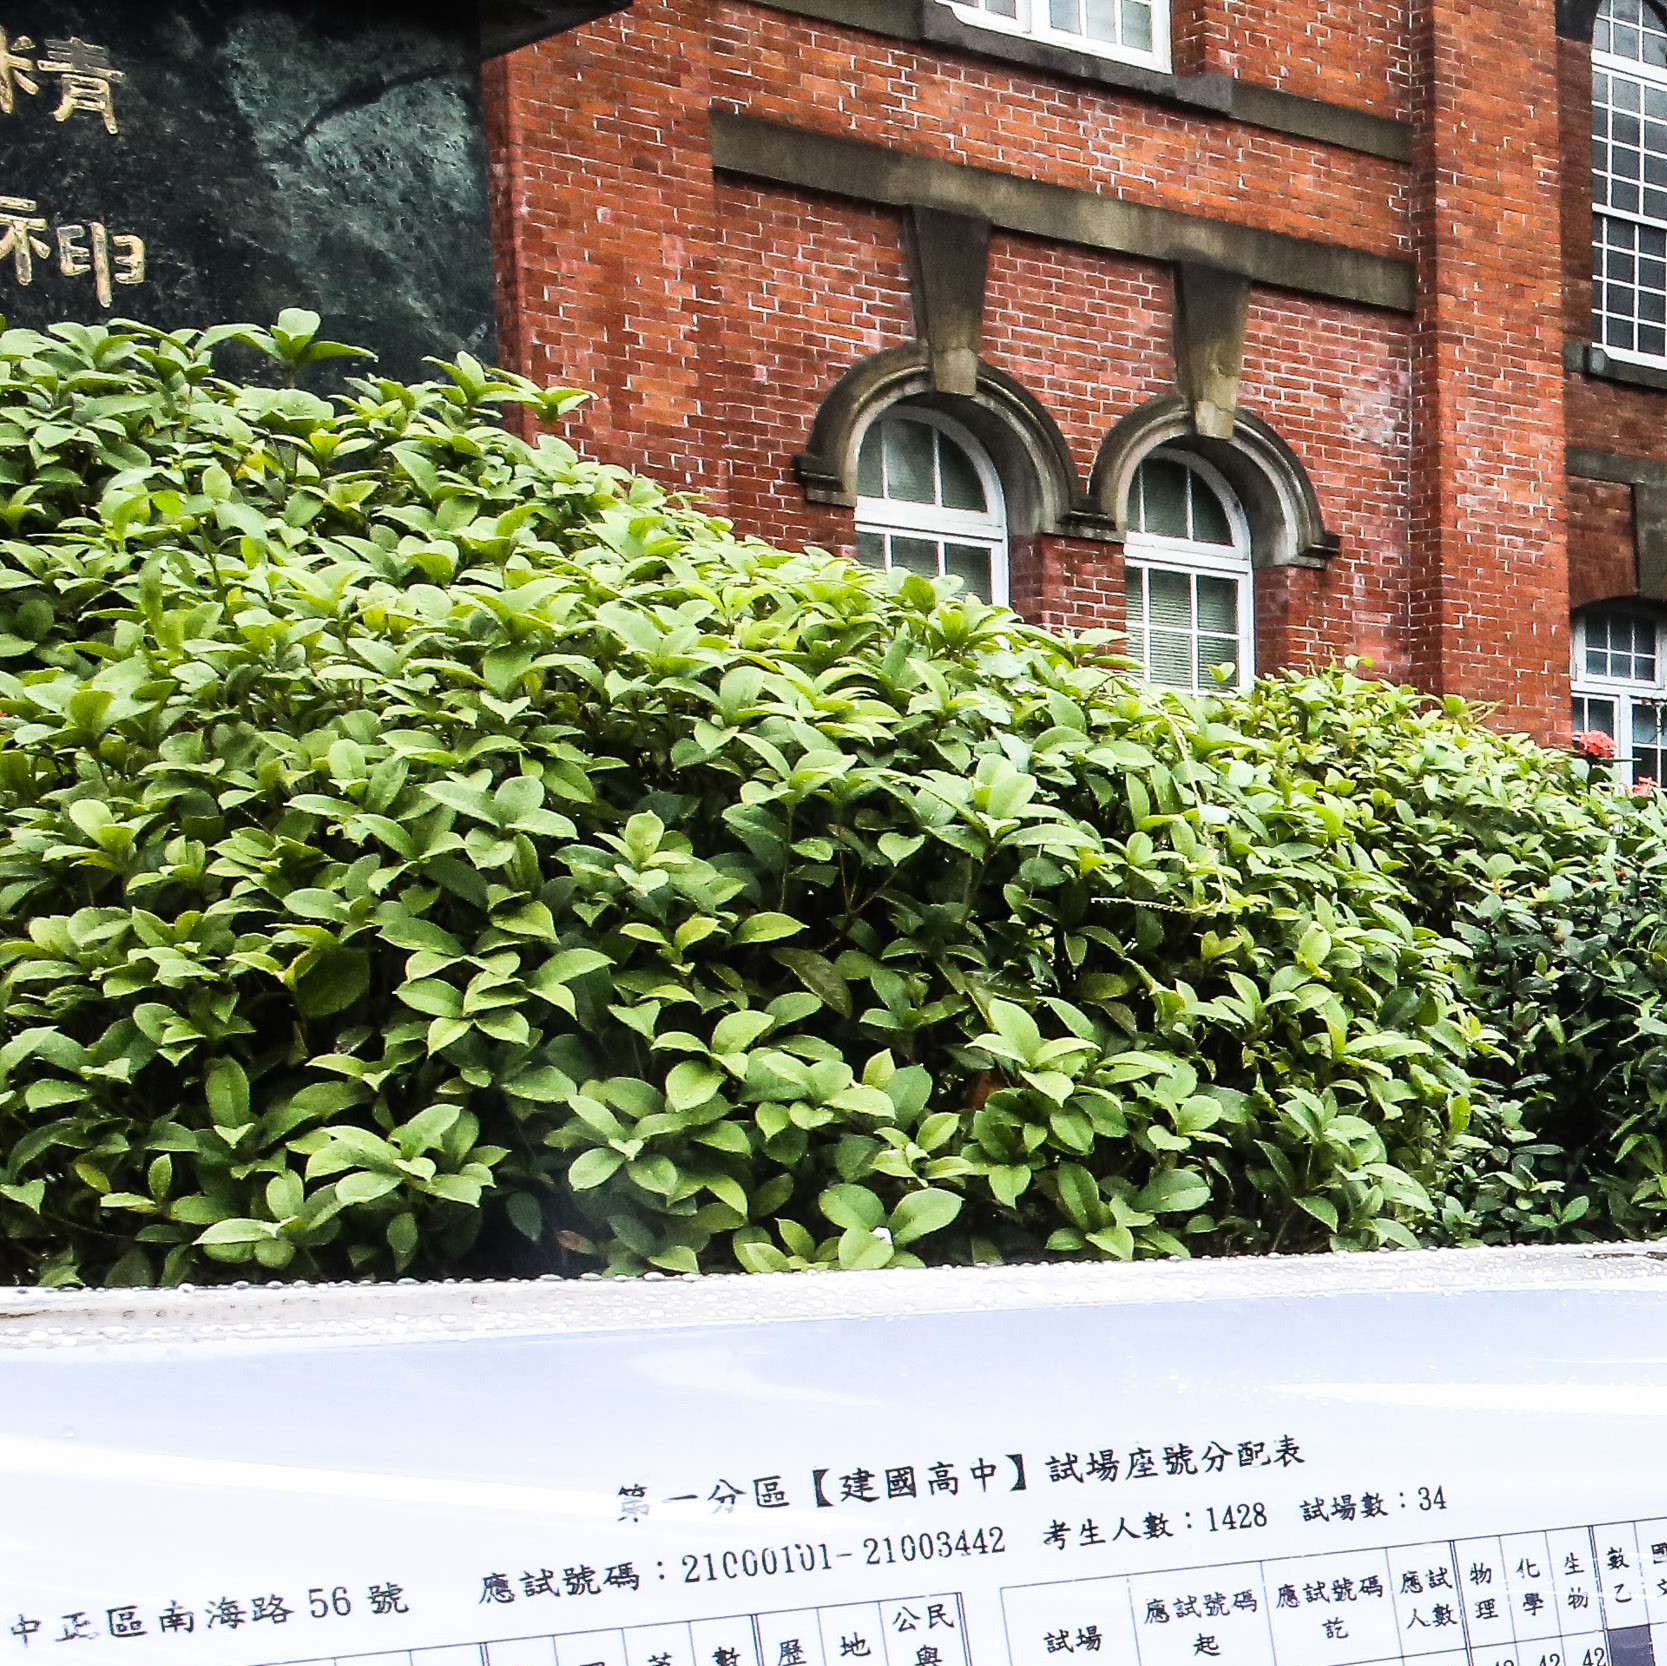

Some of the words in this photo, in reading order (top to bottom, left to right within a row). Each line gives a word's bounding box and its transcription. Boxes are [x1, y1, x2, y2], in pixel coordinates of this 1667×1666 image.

[1275, 1574, 1385, 1610] 應試號碼
[1398, 1565, 1454, 1595] 應試
[892, 1603, 956, 1635] 公民
[1144, 1588, 1259, 1627] 應試號碼
[1405, 1602, 1461, 1631] 人數
[1042, 1624, 1104, 1656] 試場
[1321, 1617, 1350, 1641] 訖
[1192, 1633, 1223, 1658] 起
